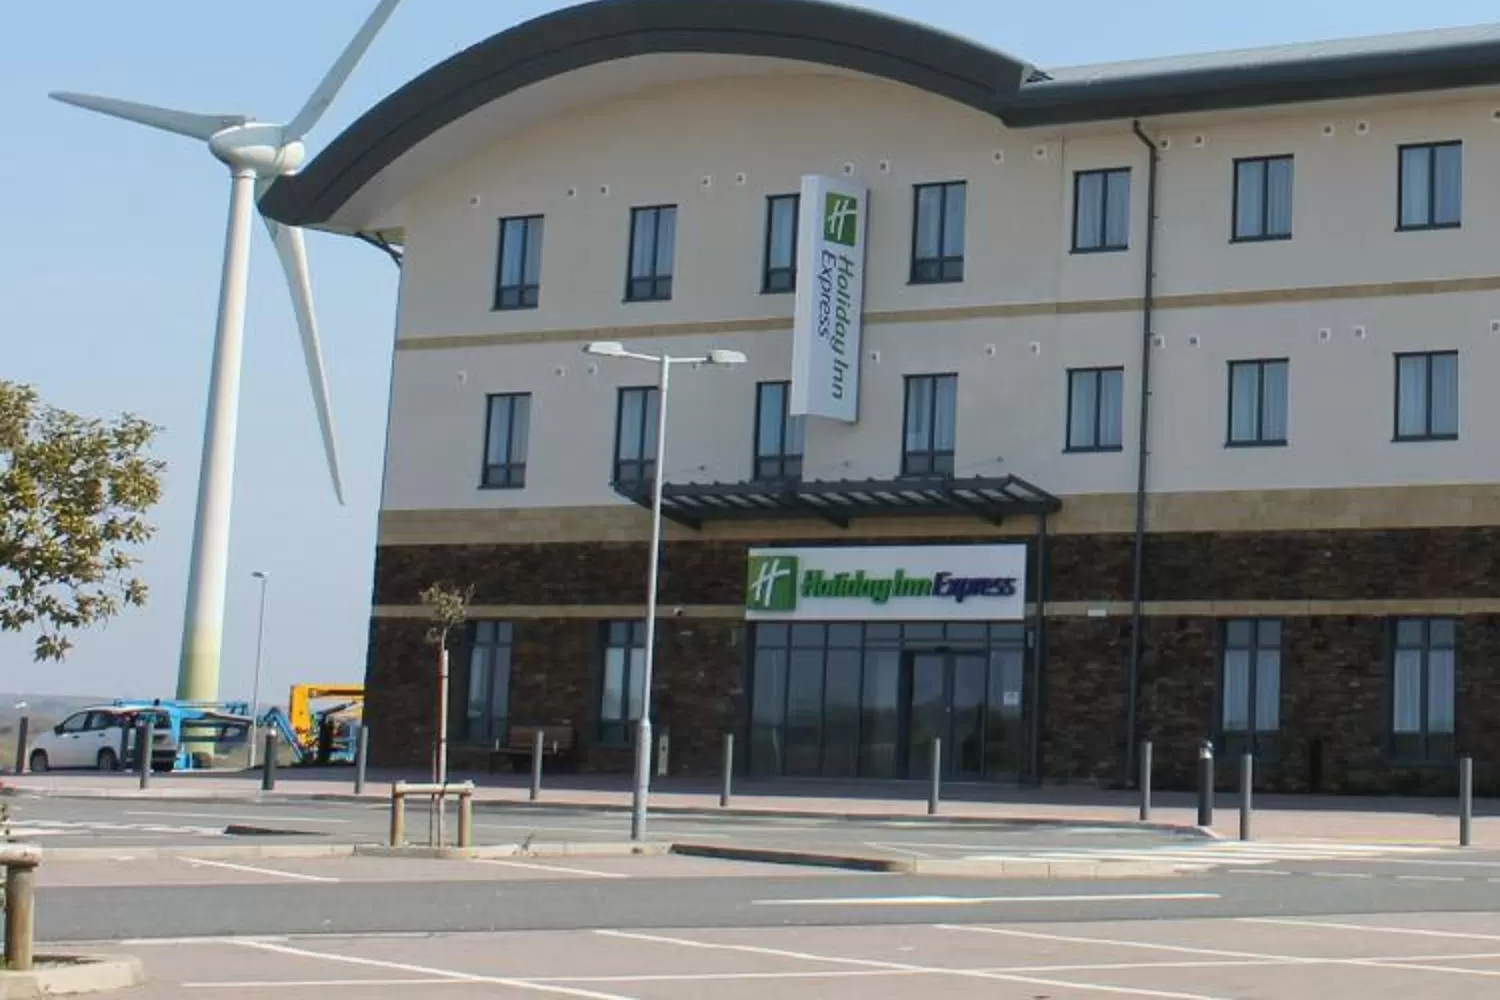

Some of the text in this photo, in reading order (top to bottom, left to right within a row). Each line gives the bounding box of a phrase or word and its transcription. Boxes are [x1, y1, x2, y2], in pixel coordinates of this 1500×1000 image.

[816, 248, 837, 338] Express
[831, 254, 854, 400] Holiday Inn
[802, 568, 1016, 604] Holiday Inn Express
